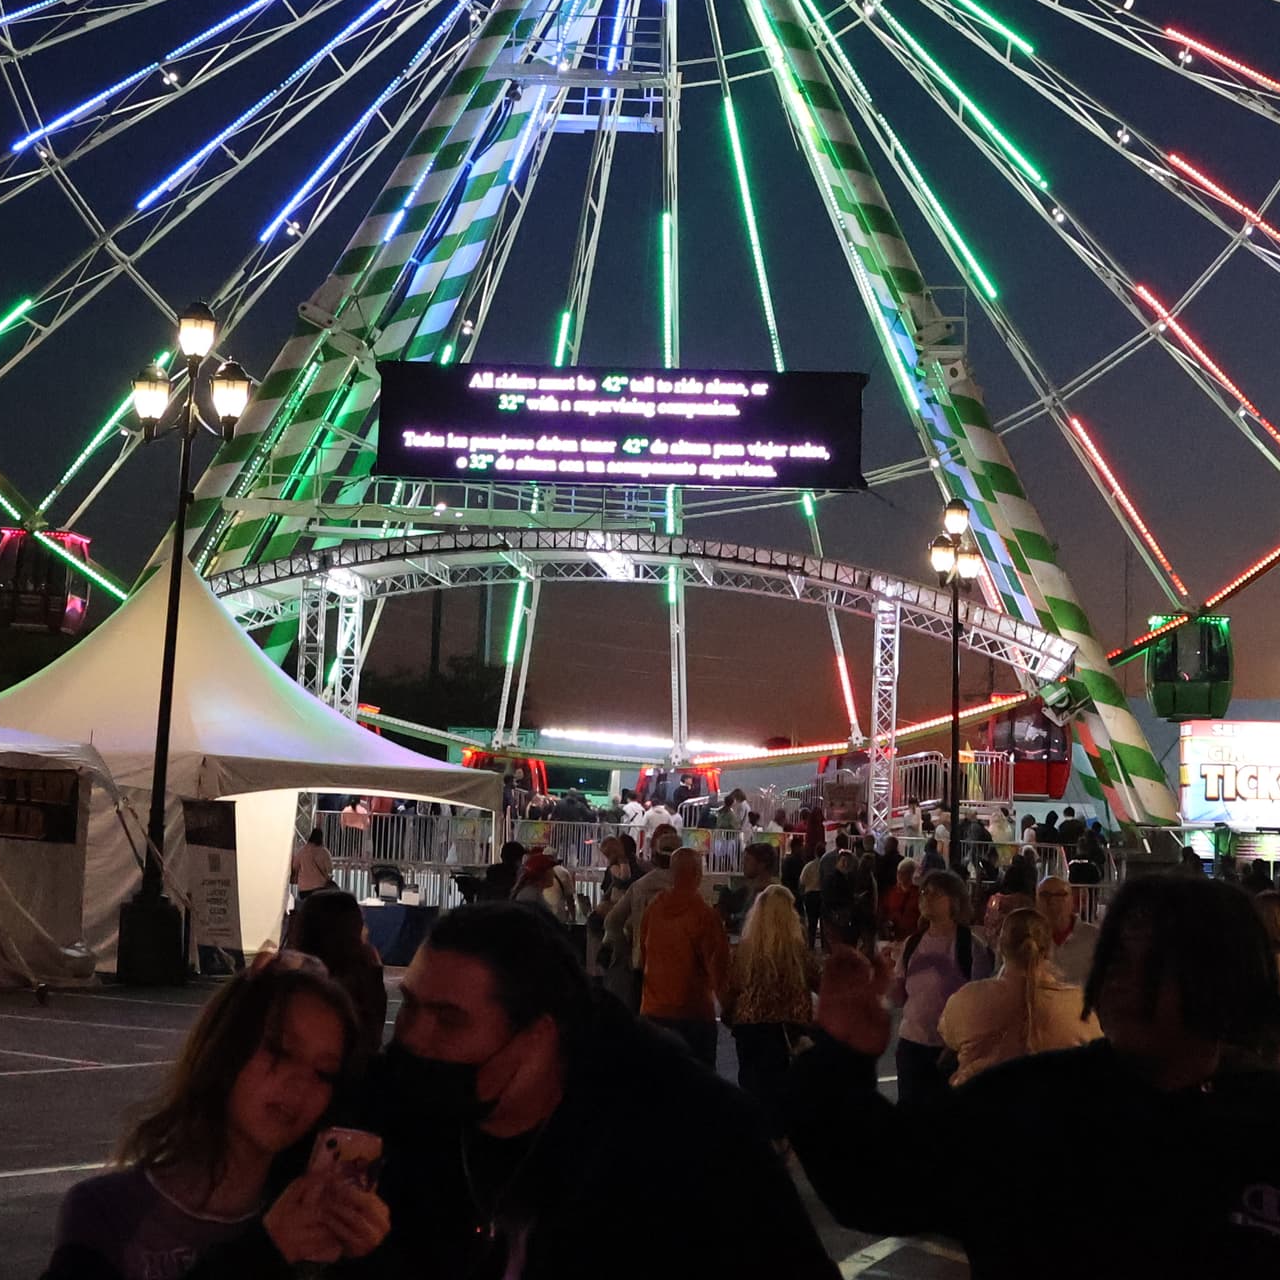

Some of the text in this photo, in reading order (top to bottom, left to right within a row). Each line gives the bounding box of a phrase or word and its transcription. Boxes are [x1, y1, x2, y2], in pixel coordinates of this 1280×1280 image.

[469, 373, 493, 388] All
[495, 373, 536, 389] riders
[577, 376, 595, 391] be
[630, 377, 654, 393] tall
[657, 379, 672, 394] to
[674, 379, 703, 394] ride
[752, 383, 768, 395] or
[527, 395, 559, 411] with
[561, 400, 571, 411] a
[403, 431, 445, 448] Todos
[650, 439, 668, 454] de
[713, 443, 744, 459] para
[748, 442, 788, 460] viajar
[495, 455, 514, 470] de
